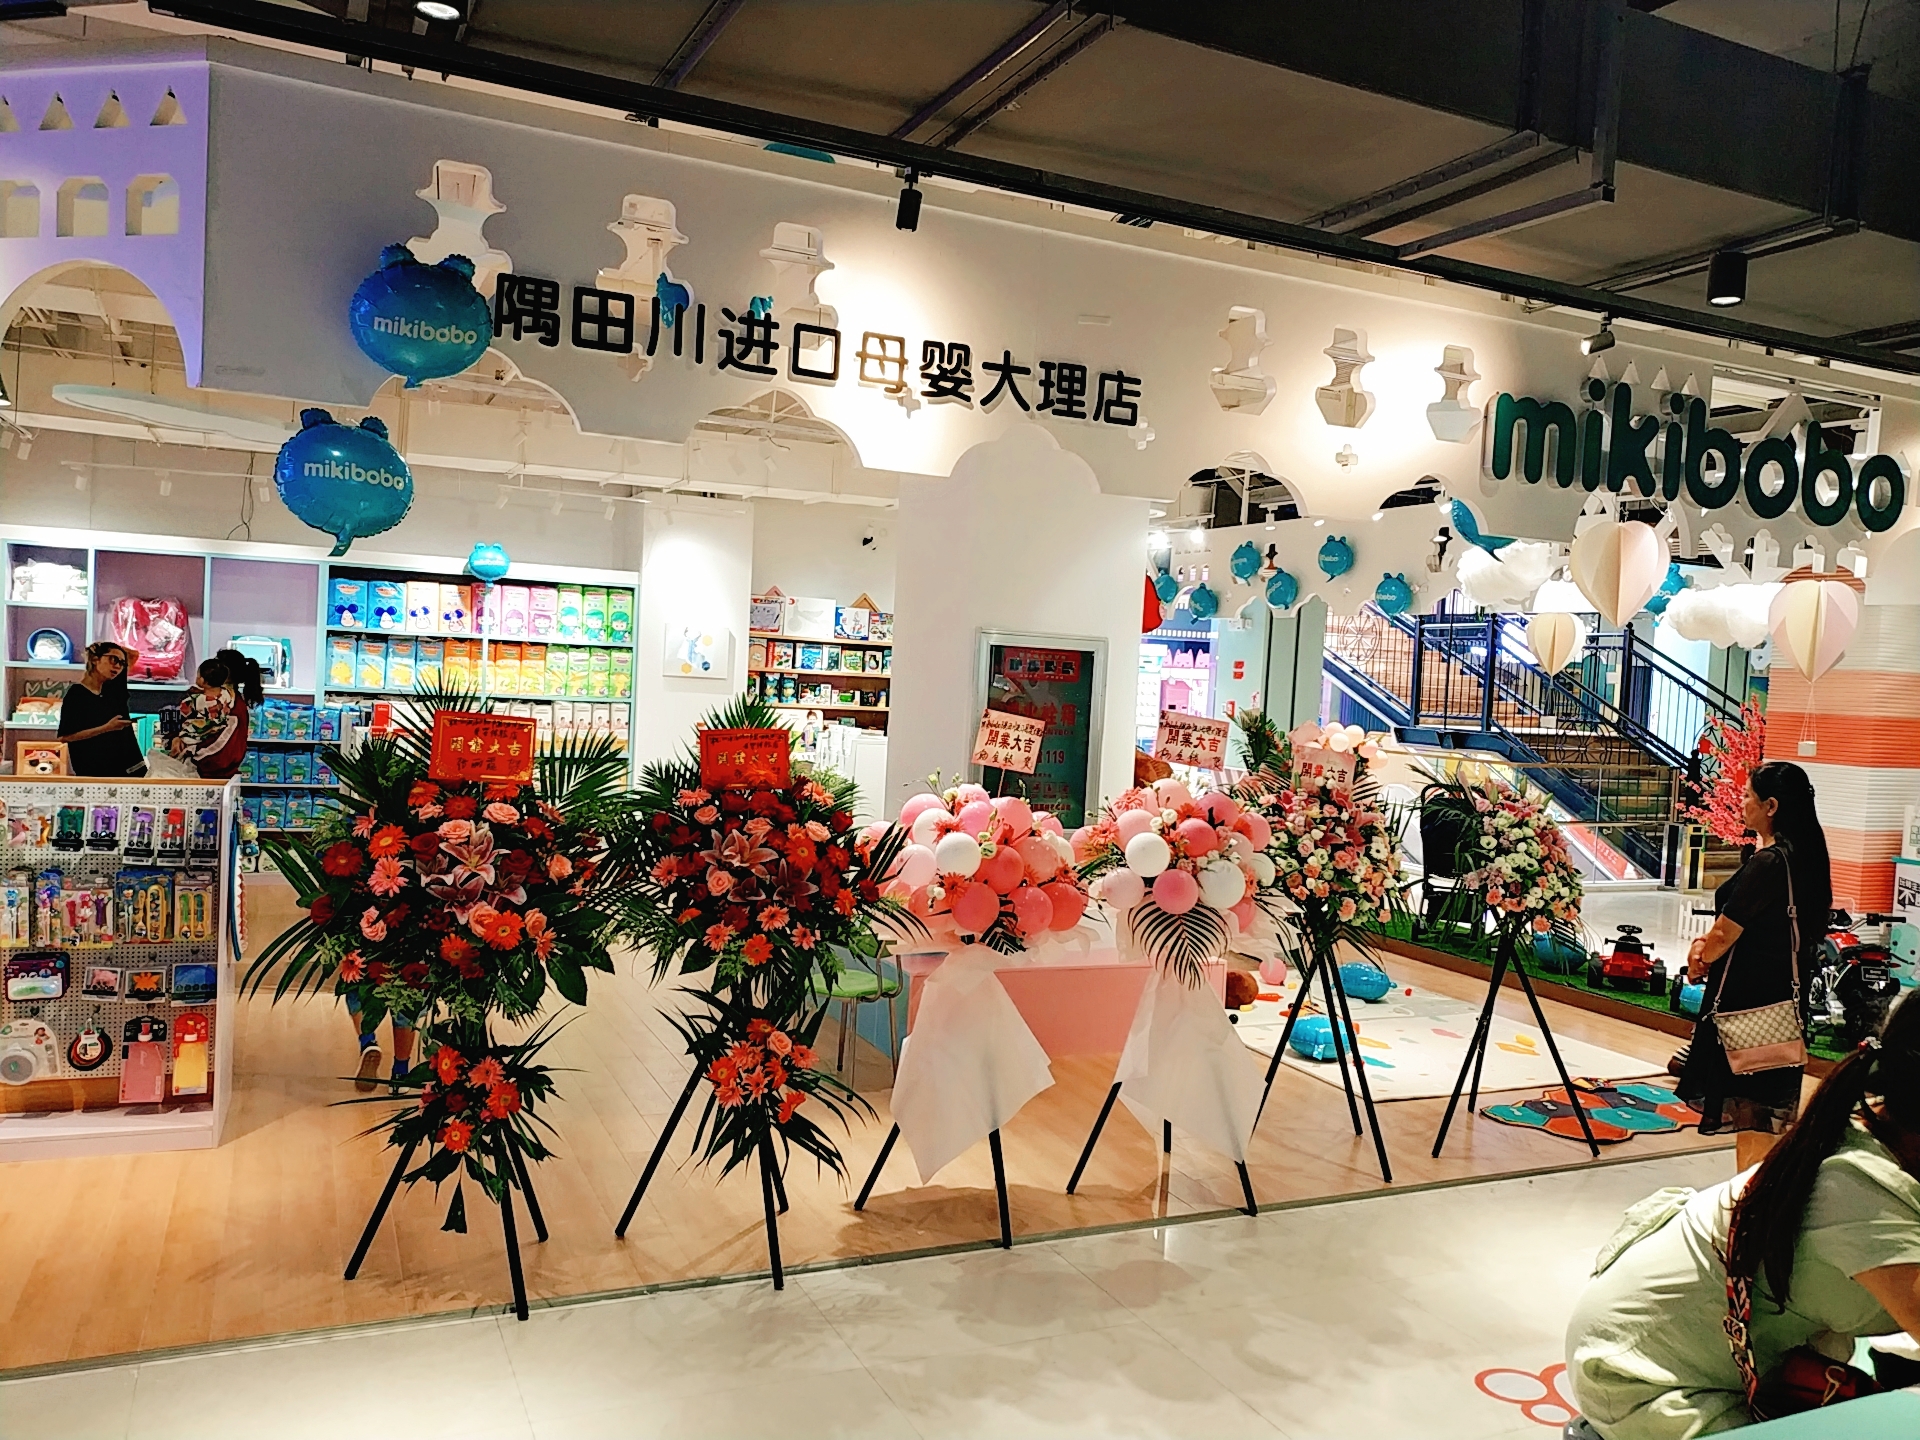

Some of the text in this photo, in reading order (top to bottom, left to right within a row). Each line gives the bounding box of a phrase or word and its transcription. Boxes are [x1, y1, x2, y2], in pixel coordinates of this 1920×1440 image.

[373, 315, 478, 345] mikibobo
[492, 272, 1144, 427] 隅田川进口母婴大理店
[303, 459, 405, 491] mikibobo
[1490, 378, 1906, 533] mikibobo
